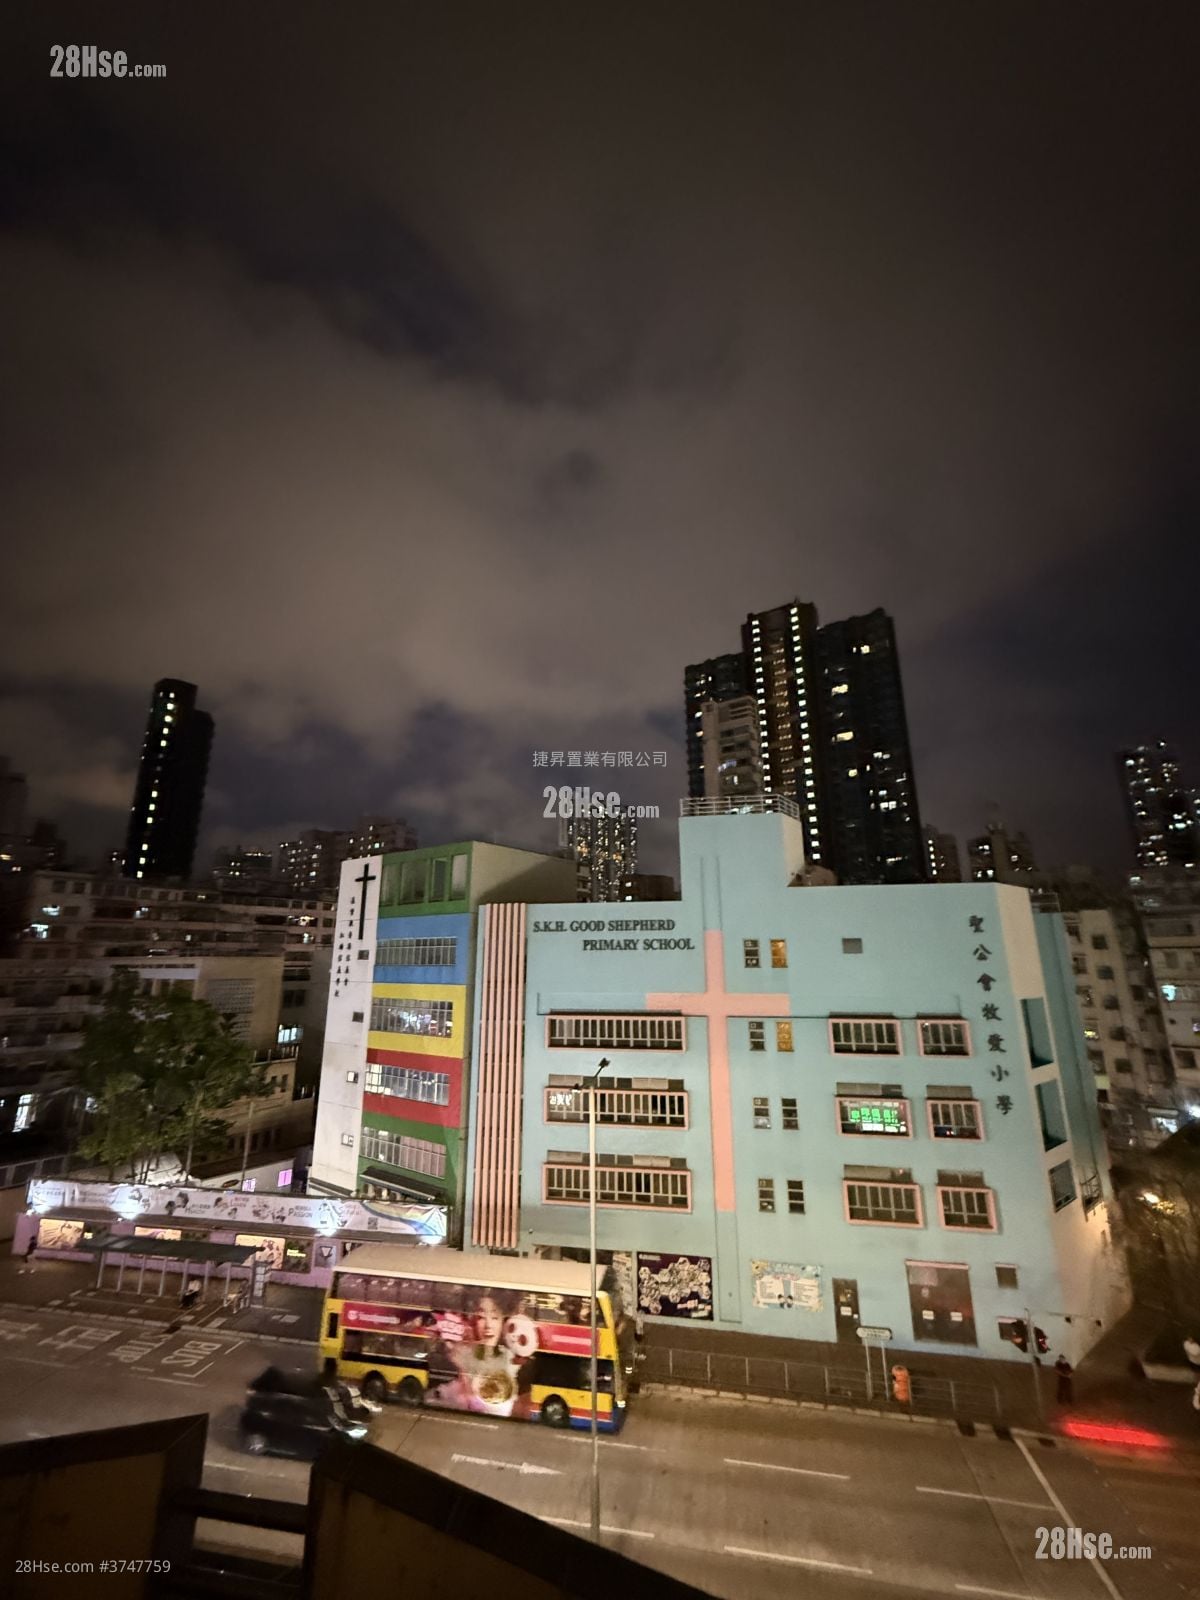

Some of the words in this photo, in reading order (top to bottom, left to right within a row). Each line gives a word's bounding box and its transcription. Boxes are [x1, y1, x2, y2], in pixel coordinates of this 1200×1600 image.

[532, 920, 567, 933] S.K.H.
[569, 919, 606, 932] GOOD
[607, 918, 676, 932] SHEPHERD
[582, 938, 640, 951] PRIMARY
[642, 937, 696, 951] SCHOOL
[160, 1340, 222, 1367] BUS
